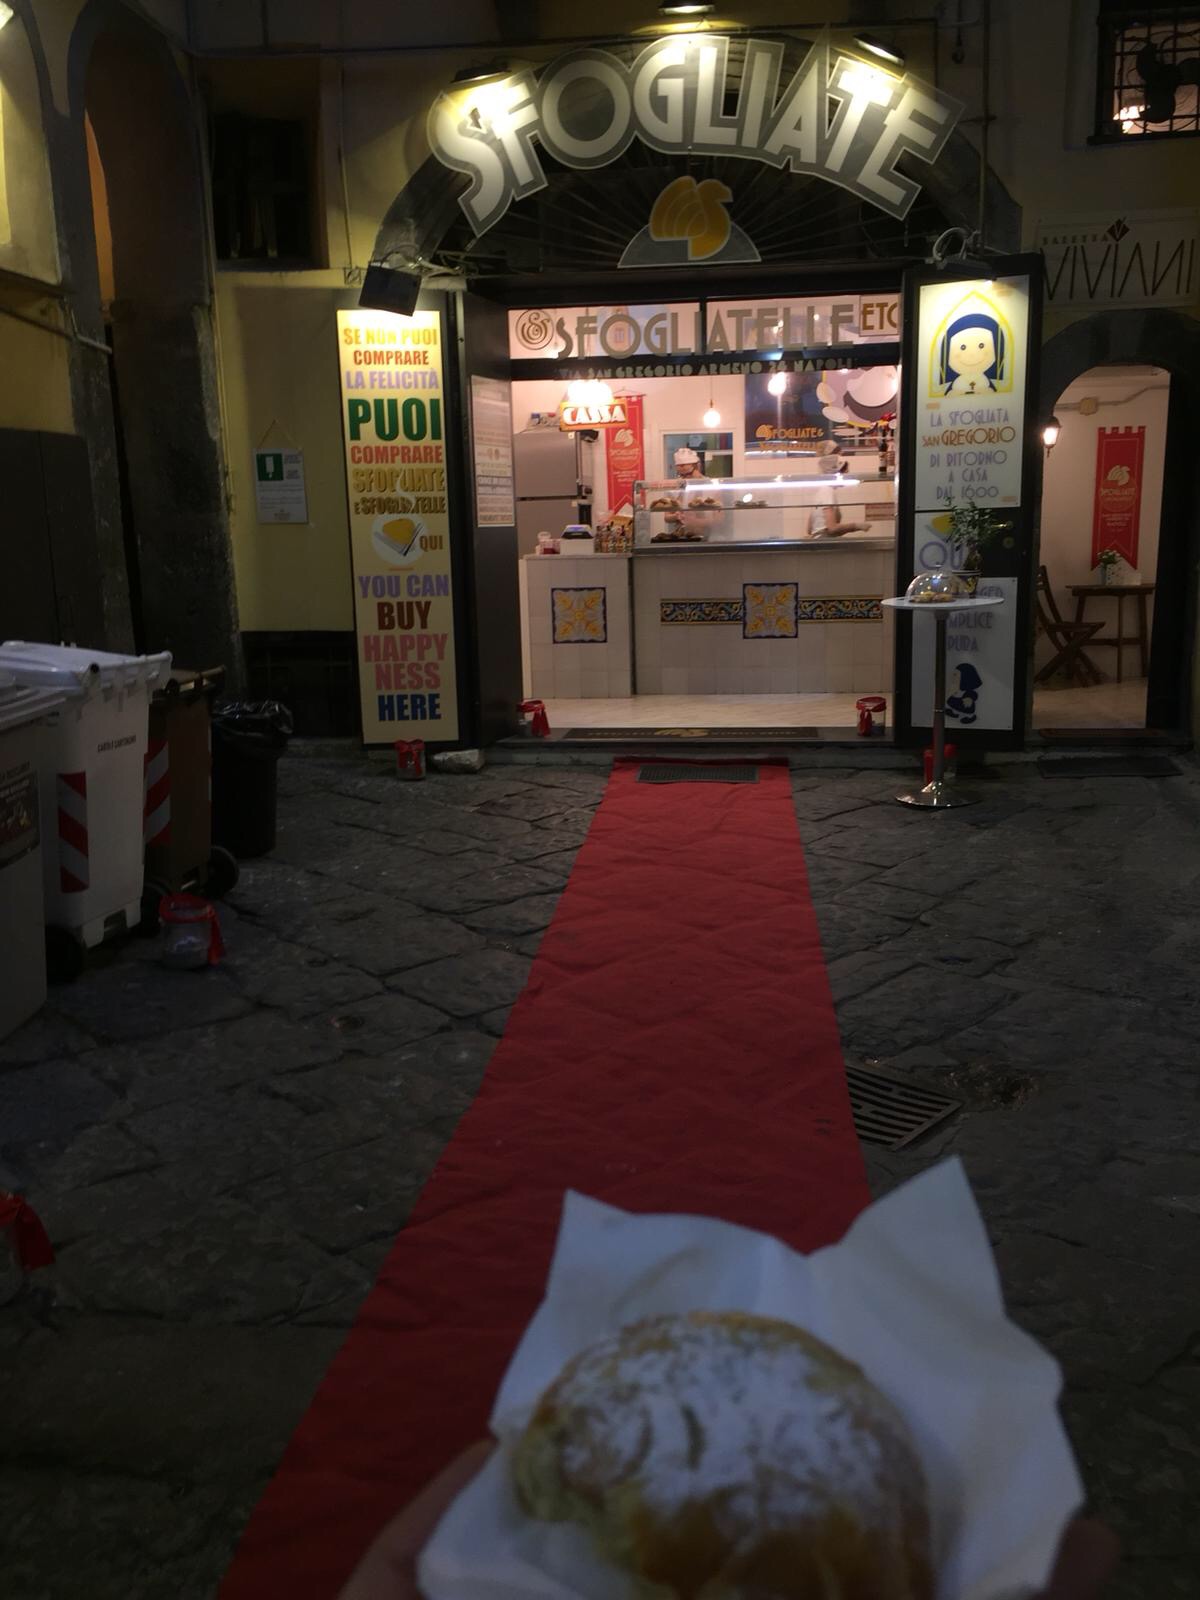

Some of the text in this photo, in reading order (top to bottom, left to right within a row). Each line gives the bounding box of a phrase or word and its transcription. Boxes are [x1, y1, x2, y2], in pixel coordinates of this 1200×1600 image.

[430, 35, 962, 228] SFOGLIATE
[343, 328, 438, 345] SE NON PUOI
[555, 303, 854, 360] SFOGLIATELLE
[353, 350, 429, 365] COMPRARE
[587, 366, 612, 379] SAN
[615, 363, 693, 378] GREGORIO
[698, 360, 763, 376] ARMENO
[793, 357, 853, 373] NAPOLI
[345, 367, 439, 389] LA FELICITÀ
[348, 397, 442, 441] PUOI
[562, 404, 625, 426] CASSA
[930, 408, 1009, 428] LA SFOGLIATA
[941, 426, 1016, 447] GREGORIO
[350, 445, 443, 464] COMPRARE
[930, 453, 940, 467] DI
[948, 467, 988, 483] A CASA
[936, 485, 999, 500] DAL 1600
[420, 535, 444, 552] QUI
[358, 574, 449, 598] YOU CAN
[377, 601, 432, 630] BUY
[363, 633, 449, 663] HAPPY
[375, 662, 441, 690] NESS
[377, 693, 442, 722] HERE
